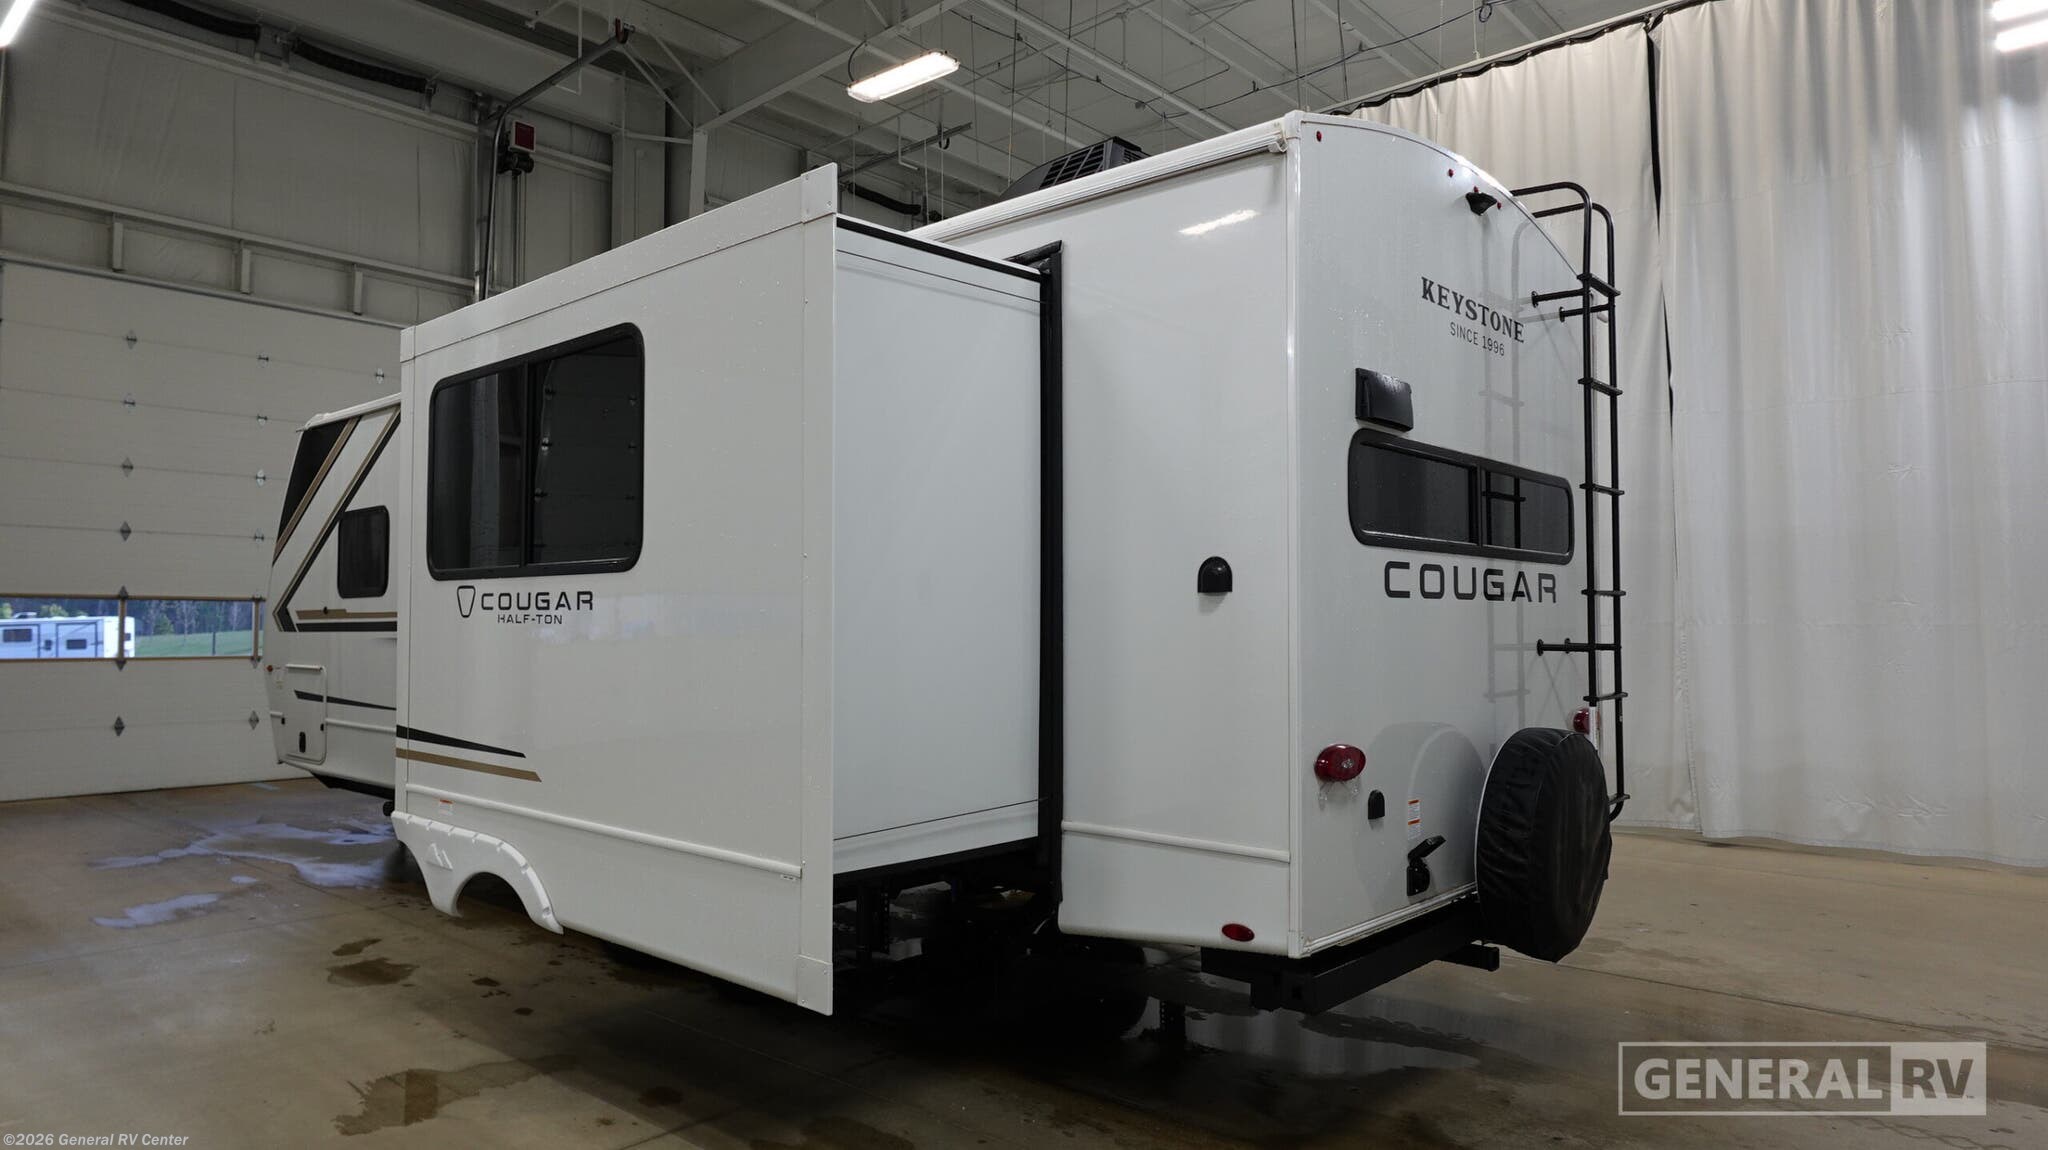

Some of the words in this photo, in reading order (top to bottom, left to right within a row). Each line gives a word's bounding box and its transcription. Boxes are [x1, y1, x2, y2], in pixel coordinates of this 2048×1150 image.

[1420, 276, 1524, 343] KEYSTONE
[1449, 321, 1479, 346] SINCE
[1482, 335, 1505, 357] 1996
[1384, 560, 1557, 603] COUGAR
[480, 591, 593, 611] COUGAR
[497, 614, 563, 625] HALF-TON
